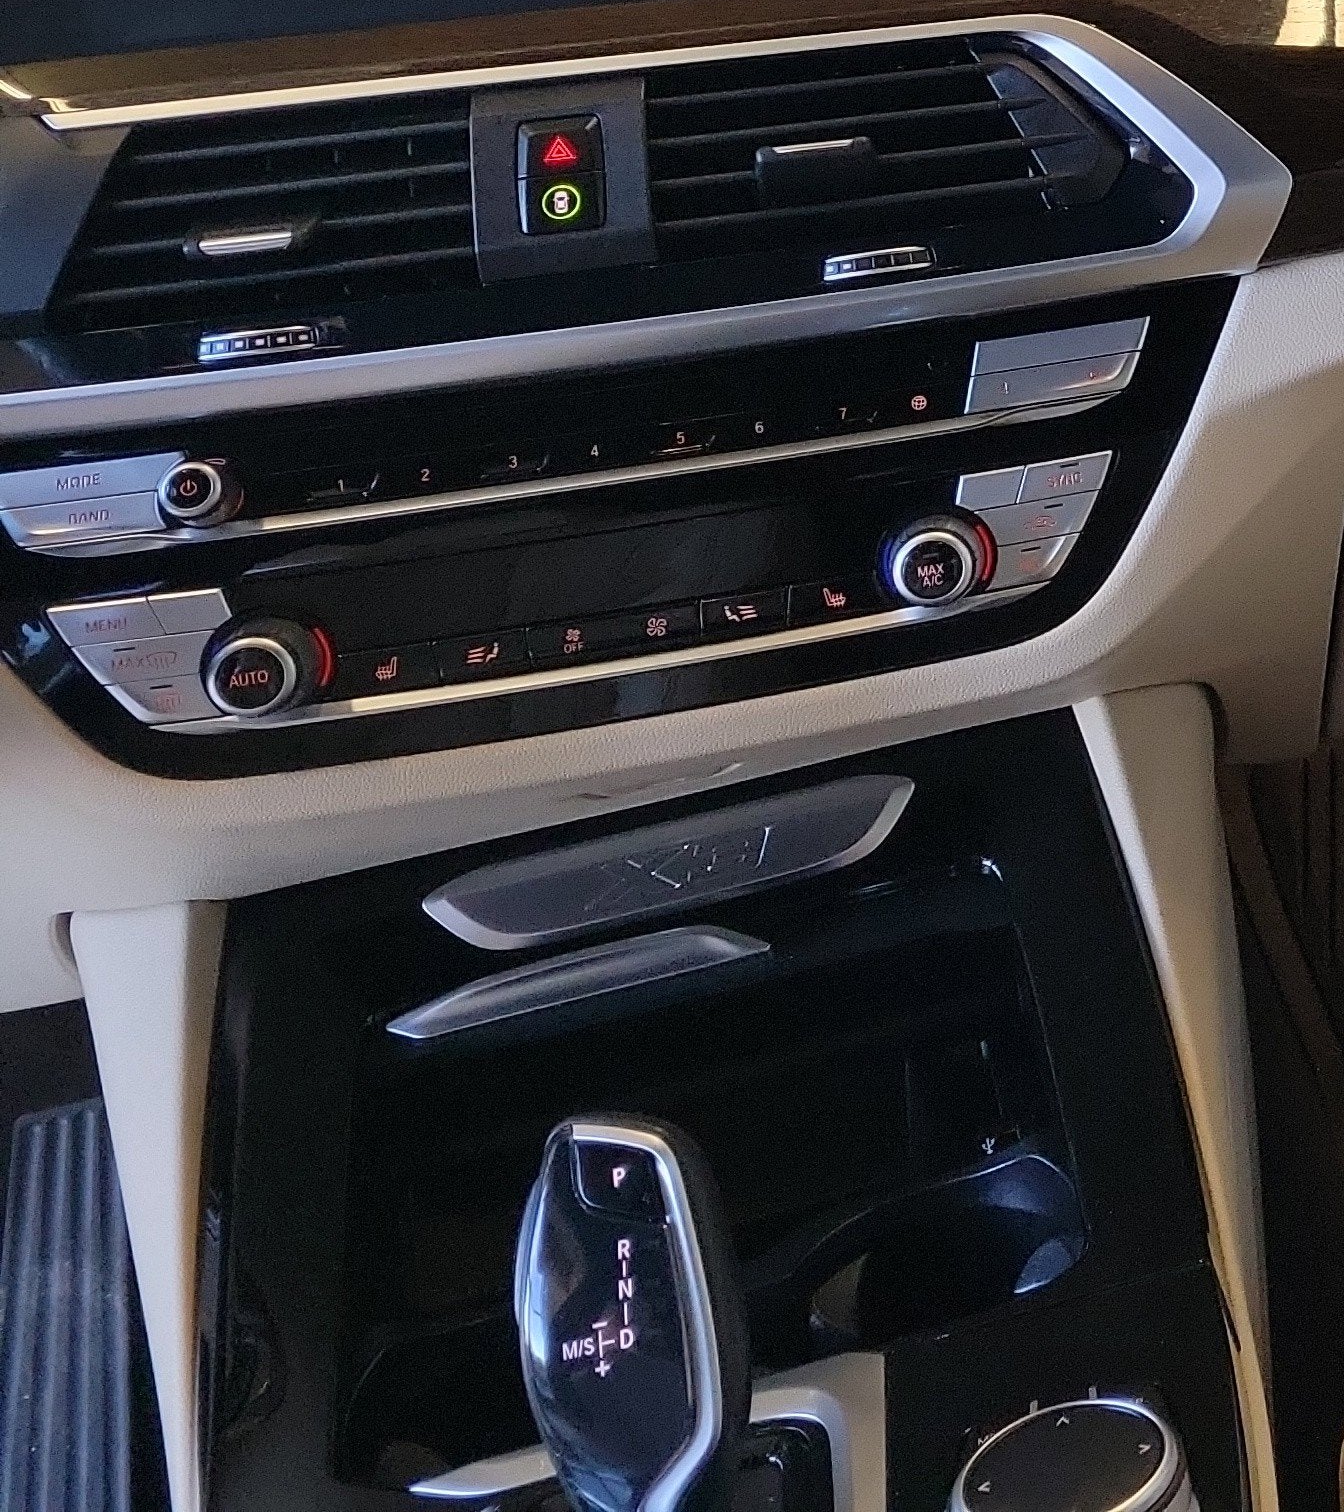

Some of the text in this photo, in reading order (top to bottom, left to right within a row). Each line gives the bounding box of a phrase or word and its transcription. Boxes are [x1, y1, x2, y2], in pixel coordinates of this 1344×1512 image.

[337, 407, 847, 492] 1 2 3 4 5 6 7
[56, 472, 101, 491] MODE
[68, 509, 110, 525] BAND
[917, 562, 944, 578] MAX
[922, 574, 944, 588] A/C
[85, 617, 127, 634] MENU
[564, 641, 585, 654] OFF
[111, 657, 144, 671] MAX
[229, 670, 269, 688] AUTO
[612, 1167, 626, 1188] P
[617, 1239, 630, 1260] R
[618, 1278, 632, 1300] N
[562, 1329, 634, 1361] M/S D
